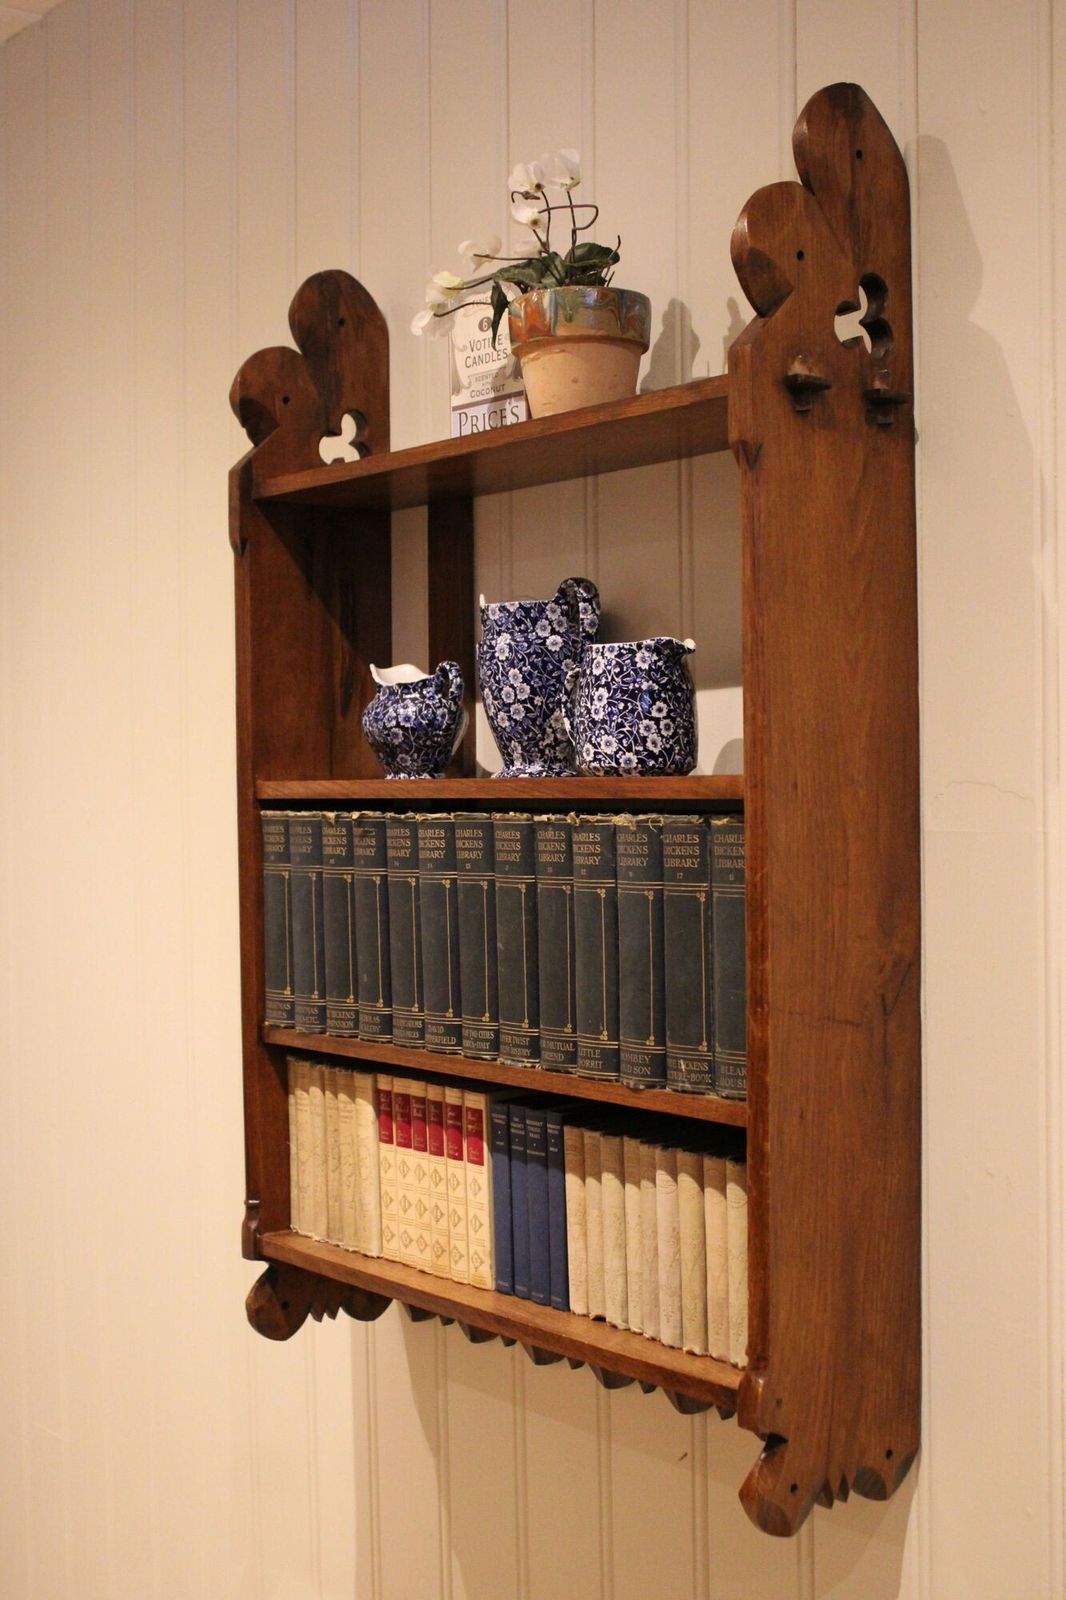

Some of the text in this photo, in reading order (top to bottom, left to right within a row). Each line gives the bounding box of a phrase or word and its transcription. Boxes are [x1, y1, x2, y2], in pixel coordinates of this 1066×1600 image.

[469, 334, 503, 353] VOTIE
[465, 348, 509, 369] CANDLES
[470, 384, 505, 399] COCONUT
[455, 829, 483, 838] CHARLES
[495, 831, 521, 839] CHARLES
[537, 831, 566, 839] CHARLES
[616, 833, 648, 843] CHARLES
[456, 839, 484, 848] DICKENS
[663, 834, 700, 844] CHARLES
[713, 834, 745, 844] CHARLE
[538, 842, 567, 851] DICKENS
[664, 846, 700, 856] DICKENS
[714, 846, 745, 856] DICKEN
[456, 850, 483, 859] LIBRARY
[538, 853, 567, 862] LIBRARY
[618, 857, 649, 867] LIBRARY
[664, 858, 700, 868] LIBRARY
[715, 859, 745, 869] LIBRAR
